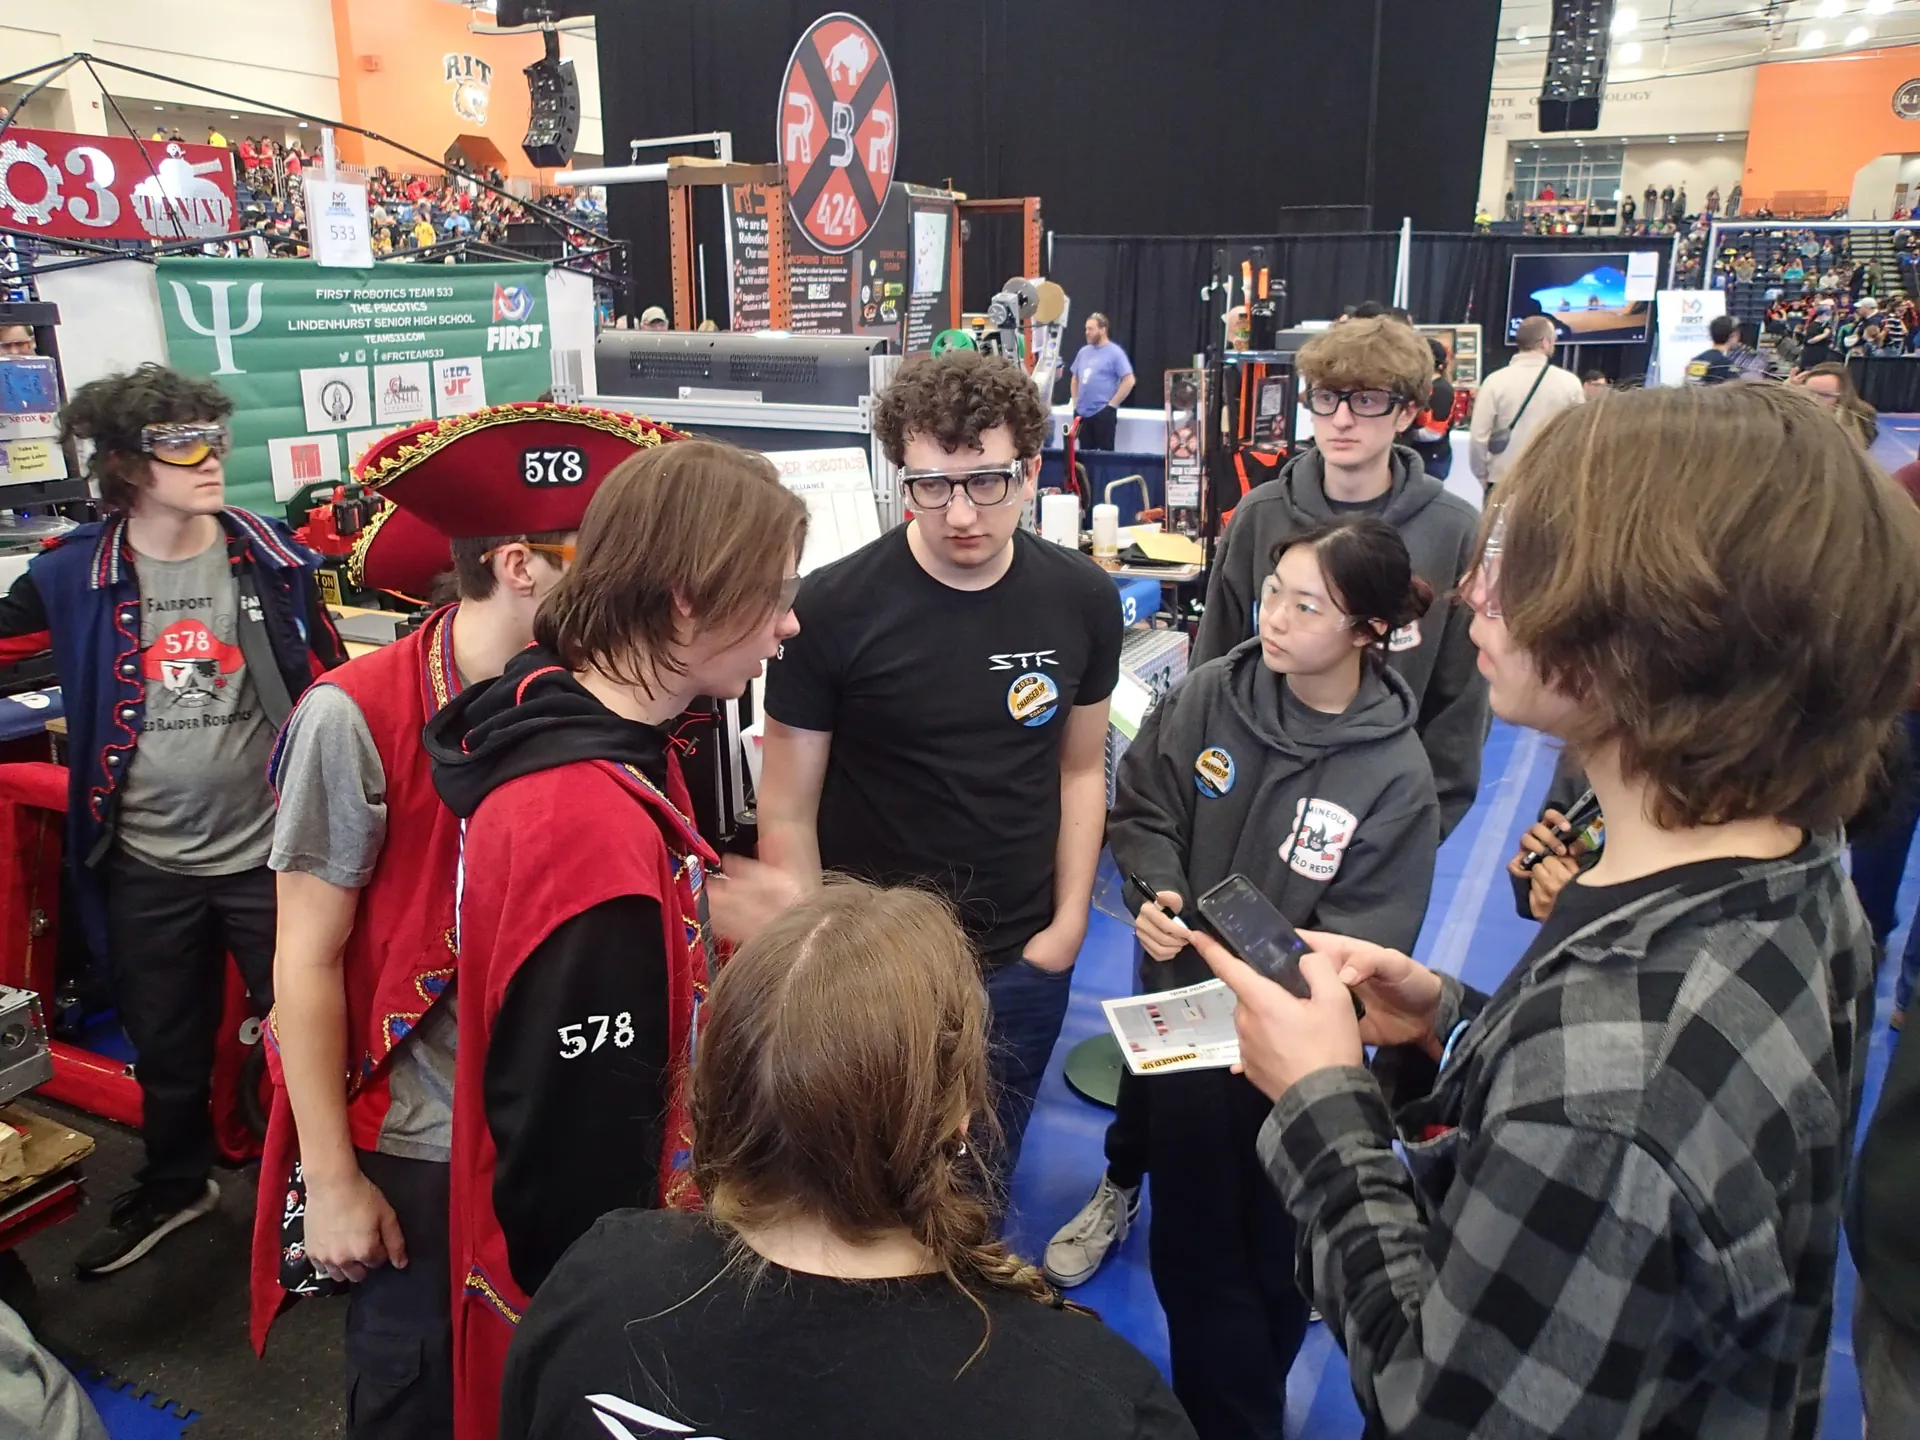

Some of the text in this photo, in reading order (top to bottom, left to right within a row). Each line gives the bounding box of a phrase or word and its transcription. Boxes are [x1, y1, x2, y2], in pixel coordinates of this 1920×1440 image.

[445, 54, 492, 86] RIT
[786, 92, 814, 163] R
[830, 101, 855, 167] B
[869, 109, 892, 174] R
[816, 192, 857, 236] 424
[330, 225, 356, 241] 533
[316, 287, 453, 300] FIRST ROBOTICS TEAM 533
[350, 302, 428, 314] THE PSICOTICS
[288, 313, 475, 331] LINDENHURST SENIOR HIGH SCHOOL
[1680, 316, 1703, 324] FIRST
[363, 332, 426, 345] TEAM533.COM
[487, 324, 543, 352] FIRST
[381, 348, 444, 361] @FRCTEAM533
[525, 451, 583, 483] 578
[148, 598, 213, 613] FAIRPORT
[164, 630, 211, 654] 578
[1016, 677, 1035, 692] 2053
[1016, 682, 1046, 711] CHARGED UP
[144, 710, 252, 732] ED RAIDER ROBOTICS
[1201, 759, 1222, 777] CHARGED
[1307, 805, 1348, 827] MINEOLA
[1309, 862, 1334, 875] REDS
[557, 1011, 635, 1059] 578
[1141, 1053, 1197, 1070] CHARGED UP
